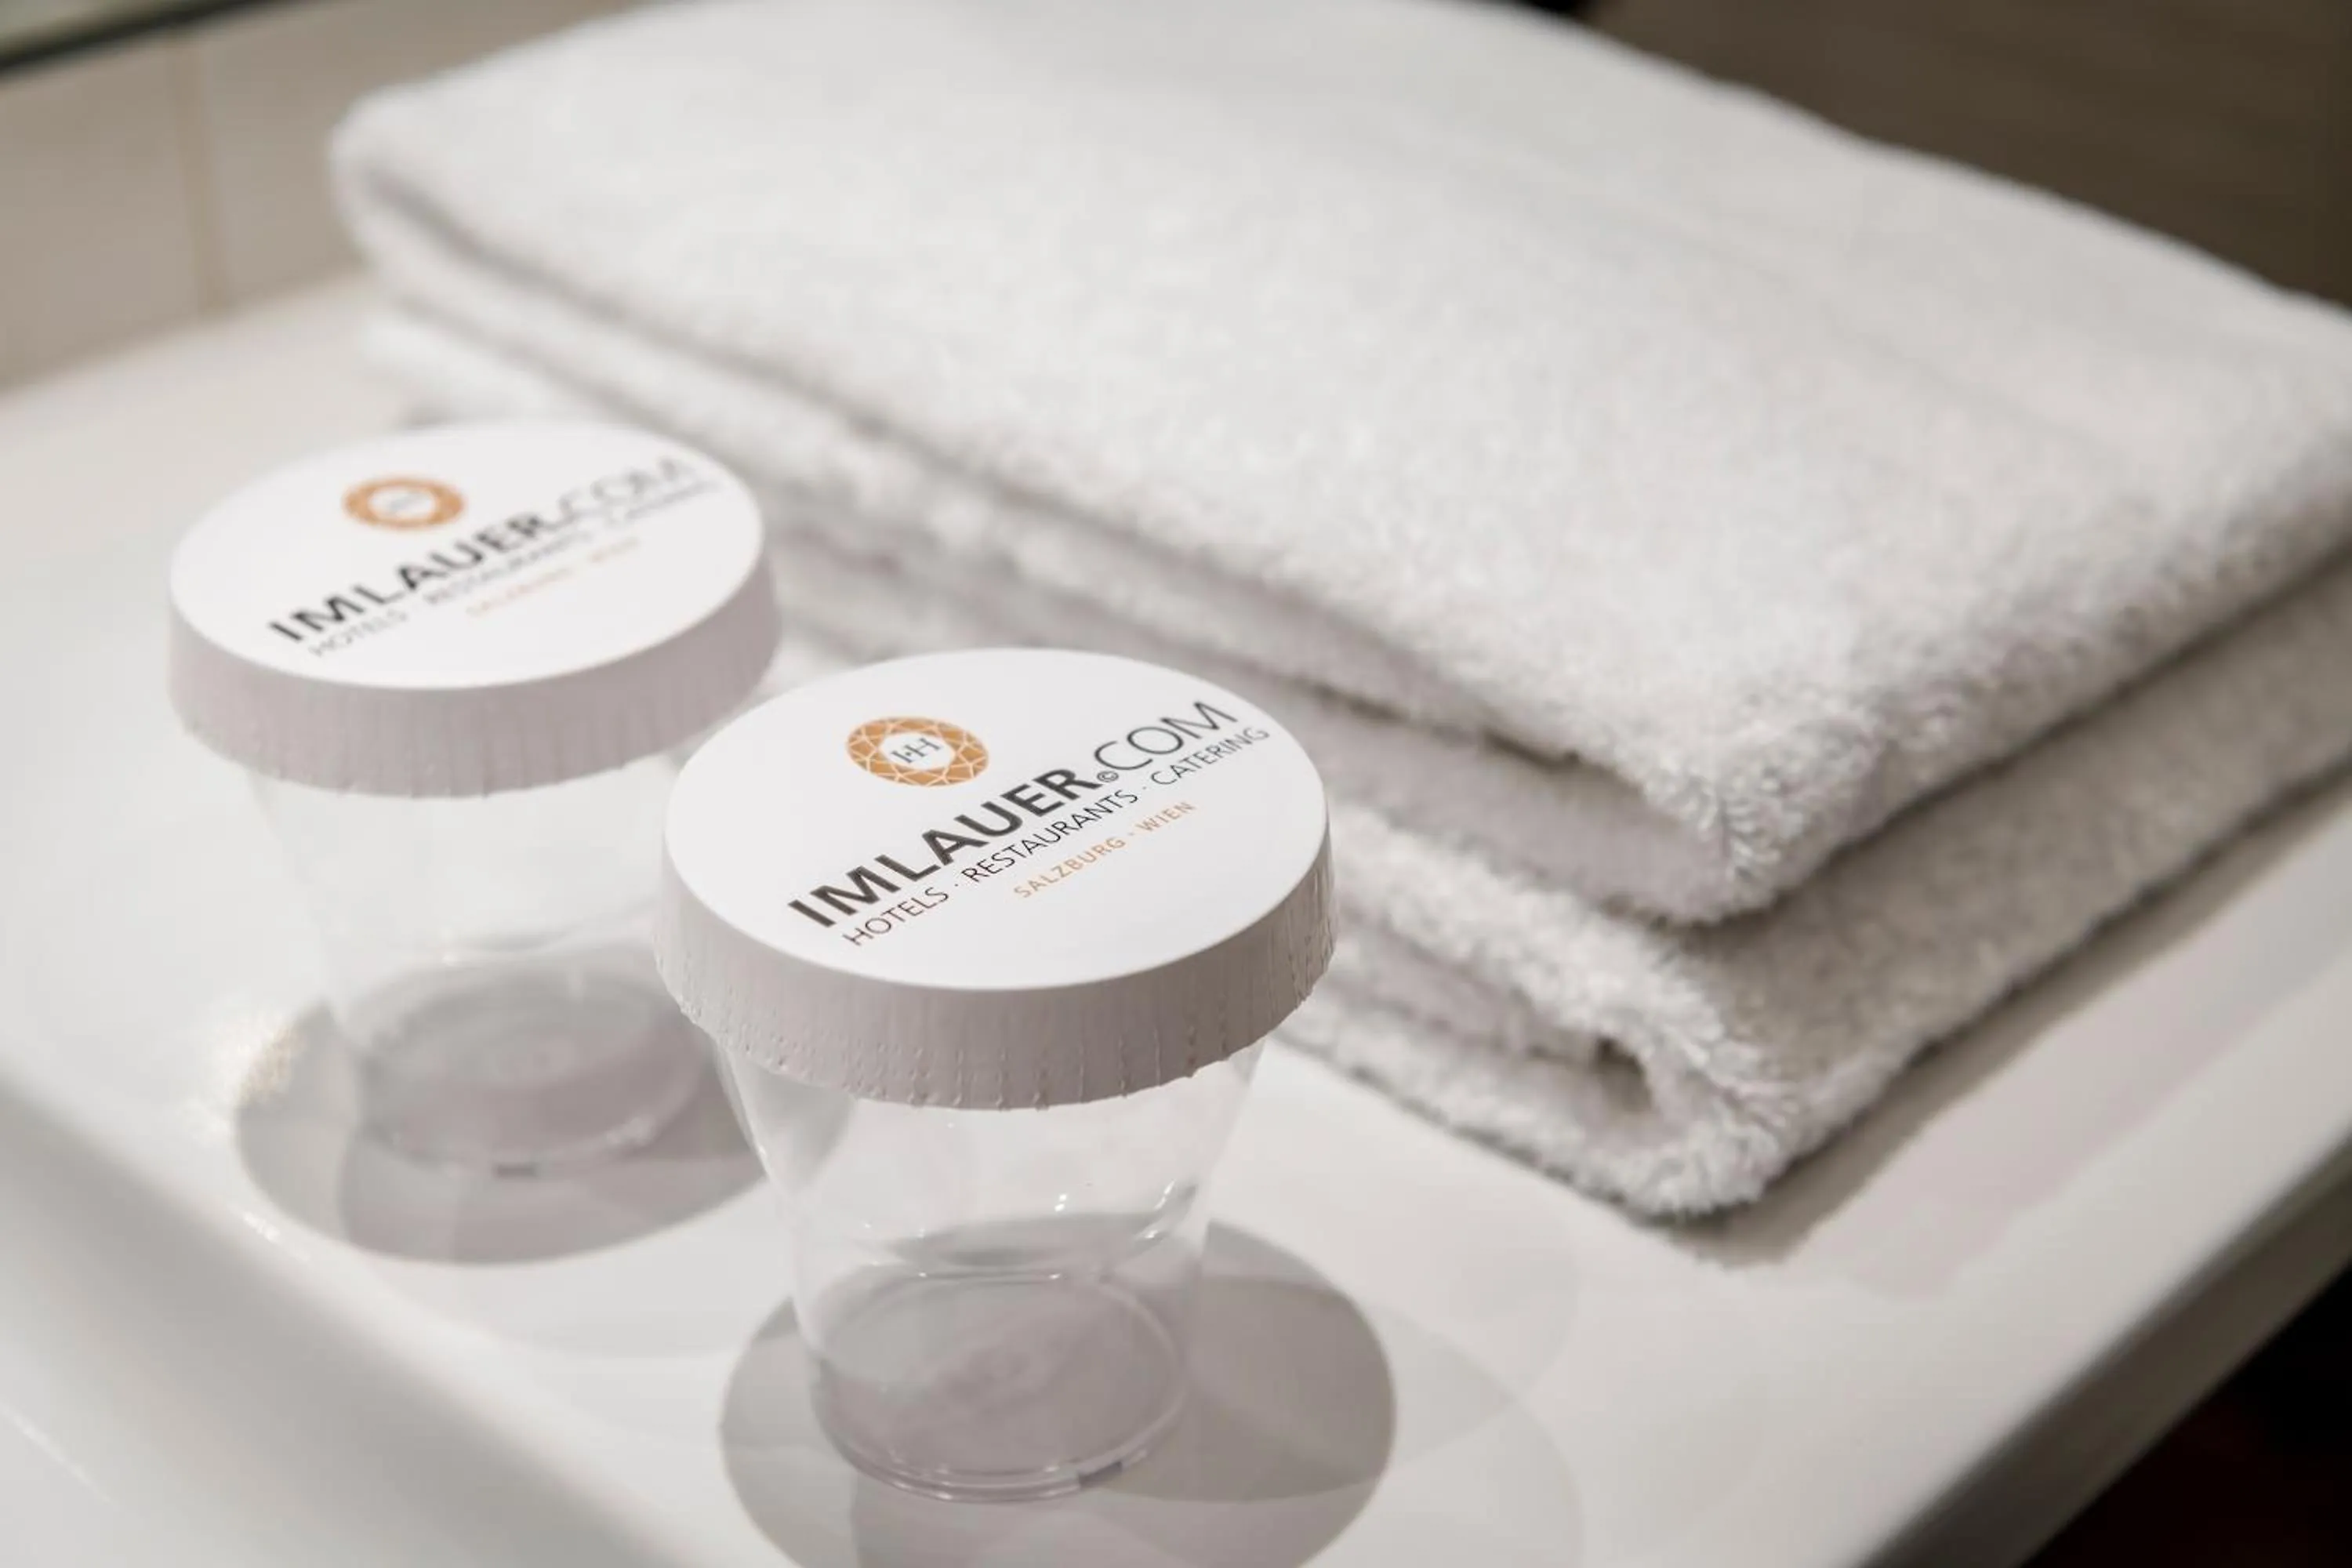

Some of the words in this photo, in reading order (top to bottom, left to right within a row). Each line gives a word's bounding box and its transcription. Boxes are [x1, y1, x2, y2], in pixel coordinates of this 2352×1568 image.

[841, 886, 950, 946] HOTELS
[960, 789, 1138, 883] RESTAURANTS
[1150, 726, 1270, 785] CATERING
[1013, 836, 1127, 898] SALZBURG
[1136, 800, 1195, 833] WIEN
